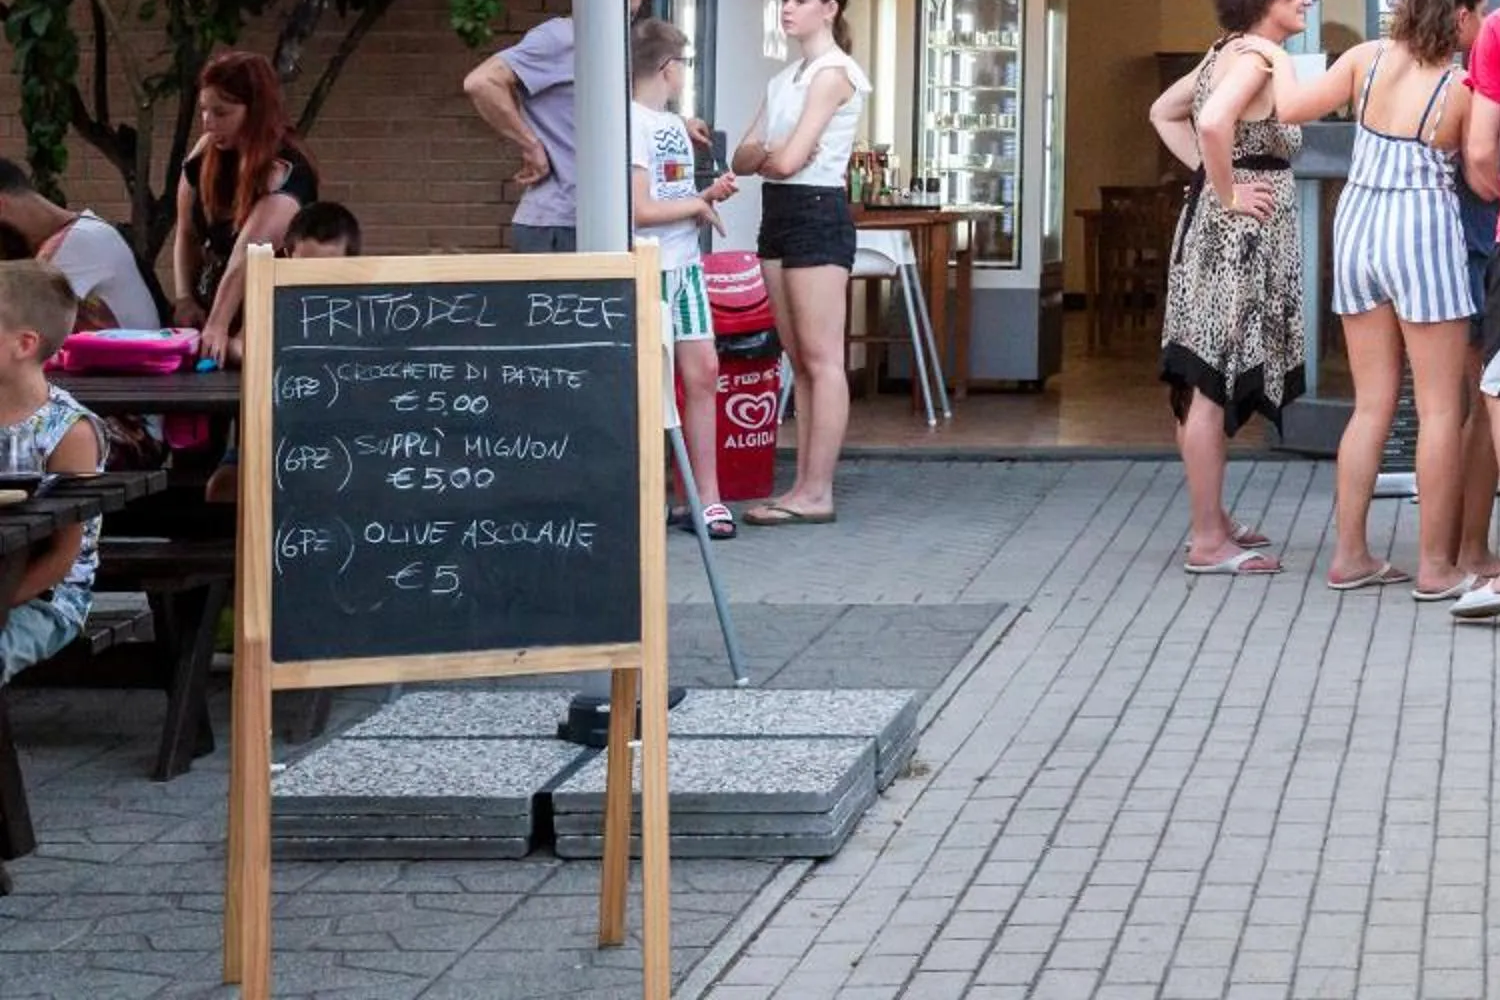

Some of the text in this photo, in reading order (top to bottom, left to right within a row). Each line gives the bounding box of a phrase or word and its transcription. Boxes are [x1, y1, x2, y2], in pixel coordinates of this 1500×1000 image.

[526, 292, 628, 330] BEEF
[465, 362, 489, 382] DI
[502, 363, 588, 389] PATATE
[464, 434, 569, 460] MIGNON
[724, 431, 776, 450] ALGIDA
[363, 520, 456, 545] OLIVE
[461, 518, 598, 550] ASCOLANE
